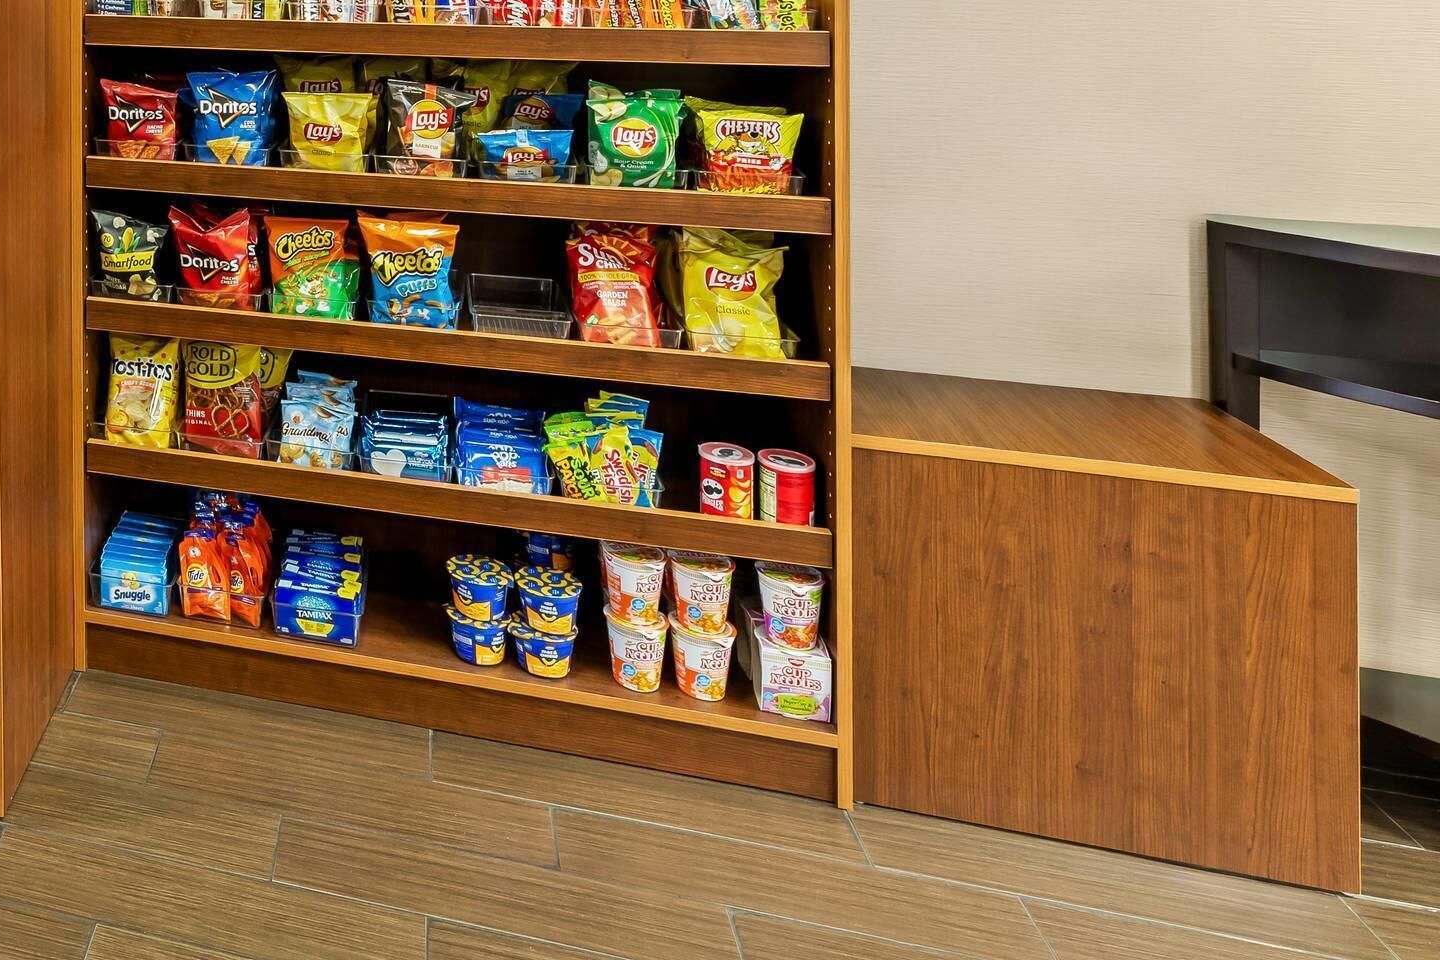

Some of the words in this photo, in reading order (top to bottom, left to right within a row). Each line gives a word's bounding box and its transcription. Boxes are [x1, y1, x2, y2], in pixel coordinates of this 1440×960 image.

[108, 105, 164, 121] Doritos
[200, 100, 257, 114] Doritos
[514, 103, 550, 119] Lay's
[412, 110, 449, 131] Lay's
[306, 123, 342, 141] Lay's
[616, 127, 655, 148] Lay's
[716, 119, 781, 141] CHESTER'S
[277, 229, 333, 261] Cheetos
[103, 254, 152, 269] Smartfood
[180, 254, 239, 272] Doritos
[373, 249, 444, 283] Cheetos
[397, 279, 437, 297] PUFFS
[709, 268, 754, 292] Lay's
[597, 290, 628, 299] GARDEN
[602, 298, 627, 307] SALSA
[716, 305, 751, 315] Classic
[190, 346, 231, 361] ROLD
[187, 360, 230, 377] GOLD
[185, 408, 205, 418] THINS
[571, 457, 595, 500] SOUR
[599, 464, 618, 496] Fish
[605, 448, 634, 505] Swedish
[187, 569, 204, 584] Tide
[113, 588, 151, 602] Snuggle
[702, 584, 726, 594] CUP
[772, 602, 818, 618] NOODLES
[784, 597, 813, 609] CUP
[296, 609, 333, 621] TAMPAX
[636, 642, 661, 653] CUP
[782, 666, 812, 679] CUP
[770, 673, 822, 691] NOODLES
